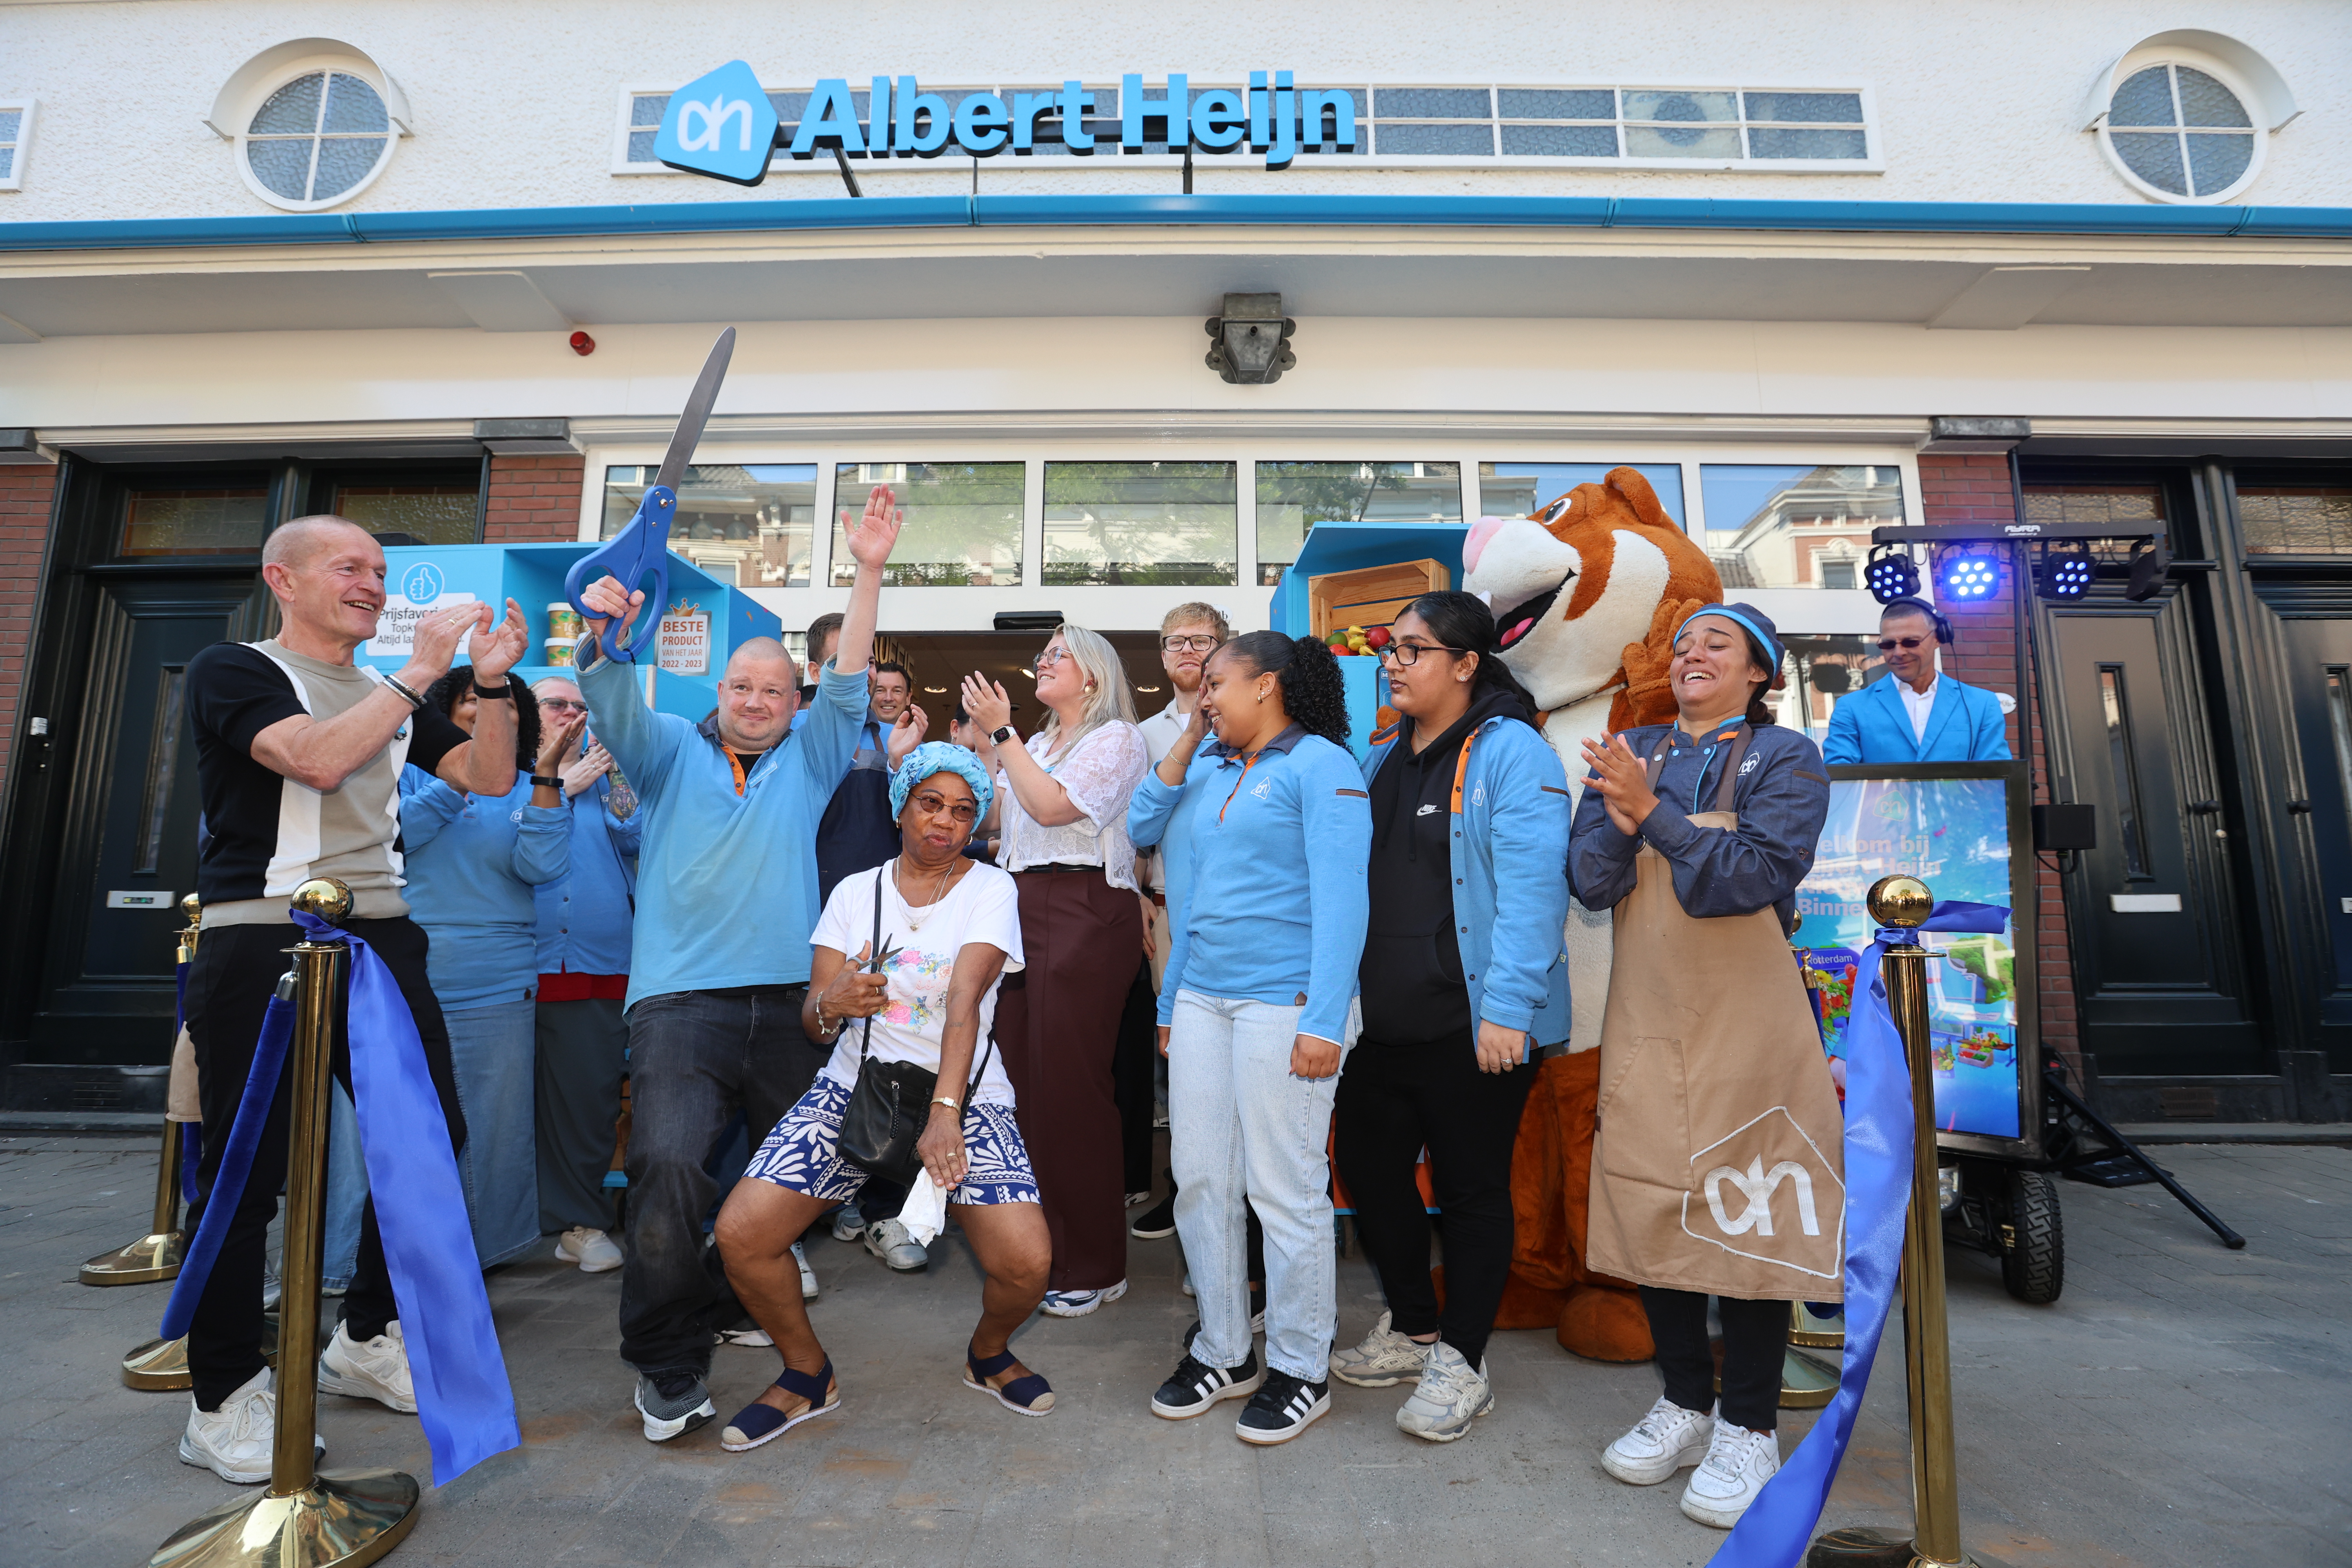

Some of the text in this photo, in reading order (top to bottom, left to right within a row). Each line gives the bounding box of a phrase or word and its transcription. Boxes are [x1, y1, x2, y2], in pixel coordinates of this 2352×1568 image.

[790, 76, 1094, 158] Albert
[1122, 71, 1356, 169] Heijn
[379, 607, 438, 622] Prijsfavori
[663, 621, 703, 632] BESTE
[377, 635, 400, 645] Altijd
[662, 636, 703, 645] PRODUCT
[1817, 835, 1929, 858] elkom bij
[1811, 855, 1942, 879] lbert Heijn
[1797, 876, 1872, 895] Nieuw
[1797, 897, 1871, 917] Binne
[1807, 955, 1853, 965] Rotterdam
[241, 1382, 257, 1394] 991
